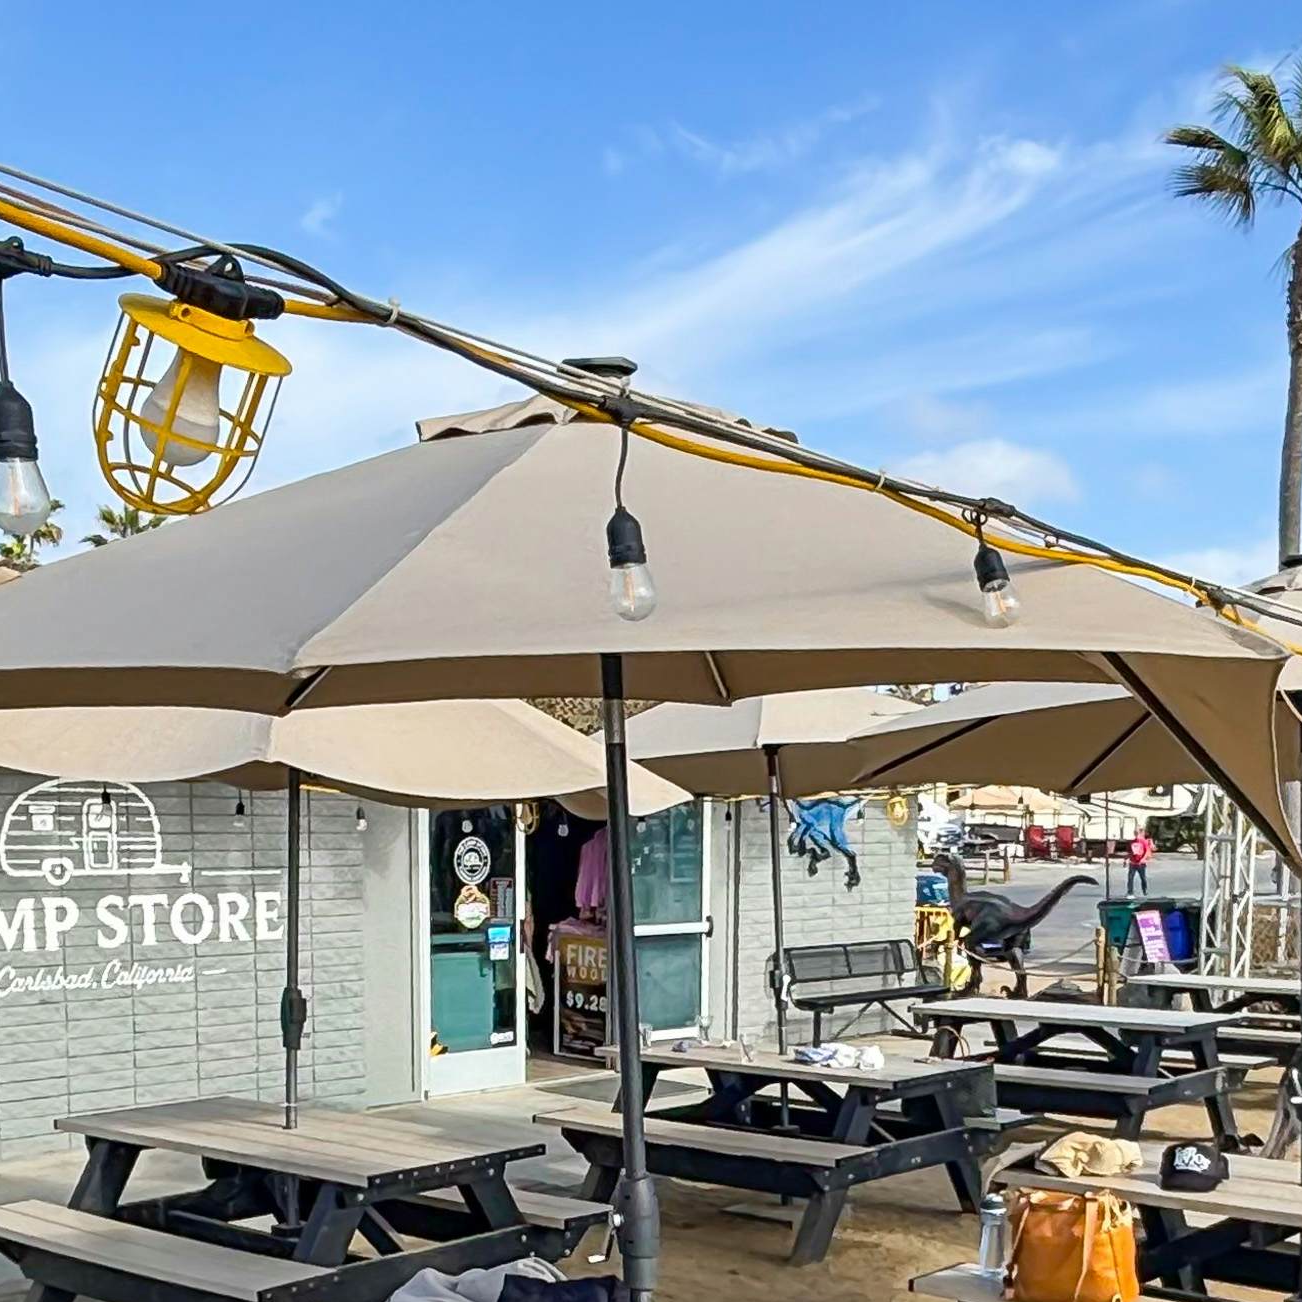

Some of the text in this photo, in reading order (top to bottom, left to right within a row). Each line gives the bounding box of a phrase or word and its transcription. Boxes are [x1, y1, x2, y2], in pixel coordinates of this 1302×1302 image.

[96, 891, 286, 948] STORE
[566, 944, 607, 969] FIRE
[101, 959, 195, 990] California
